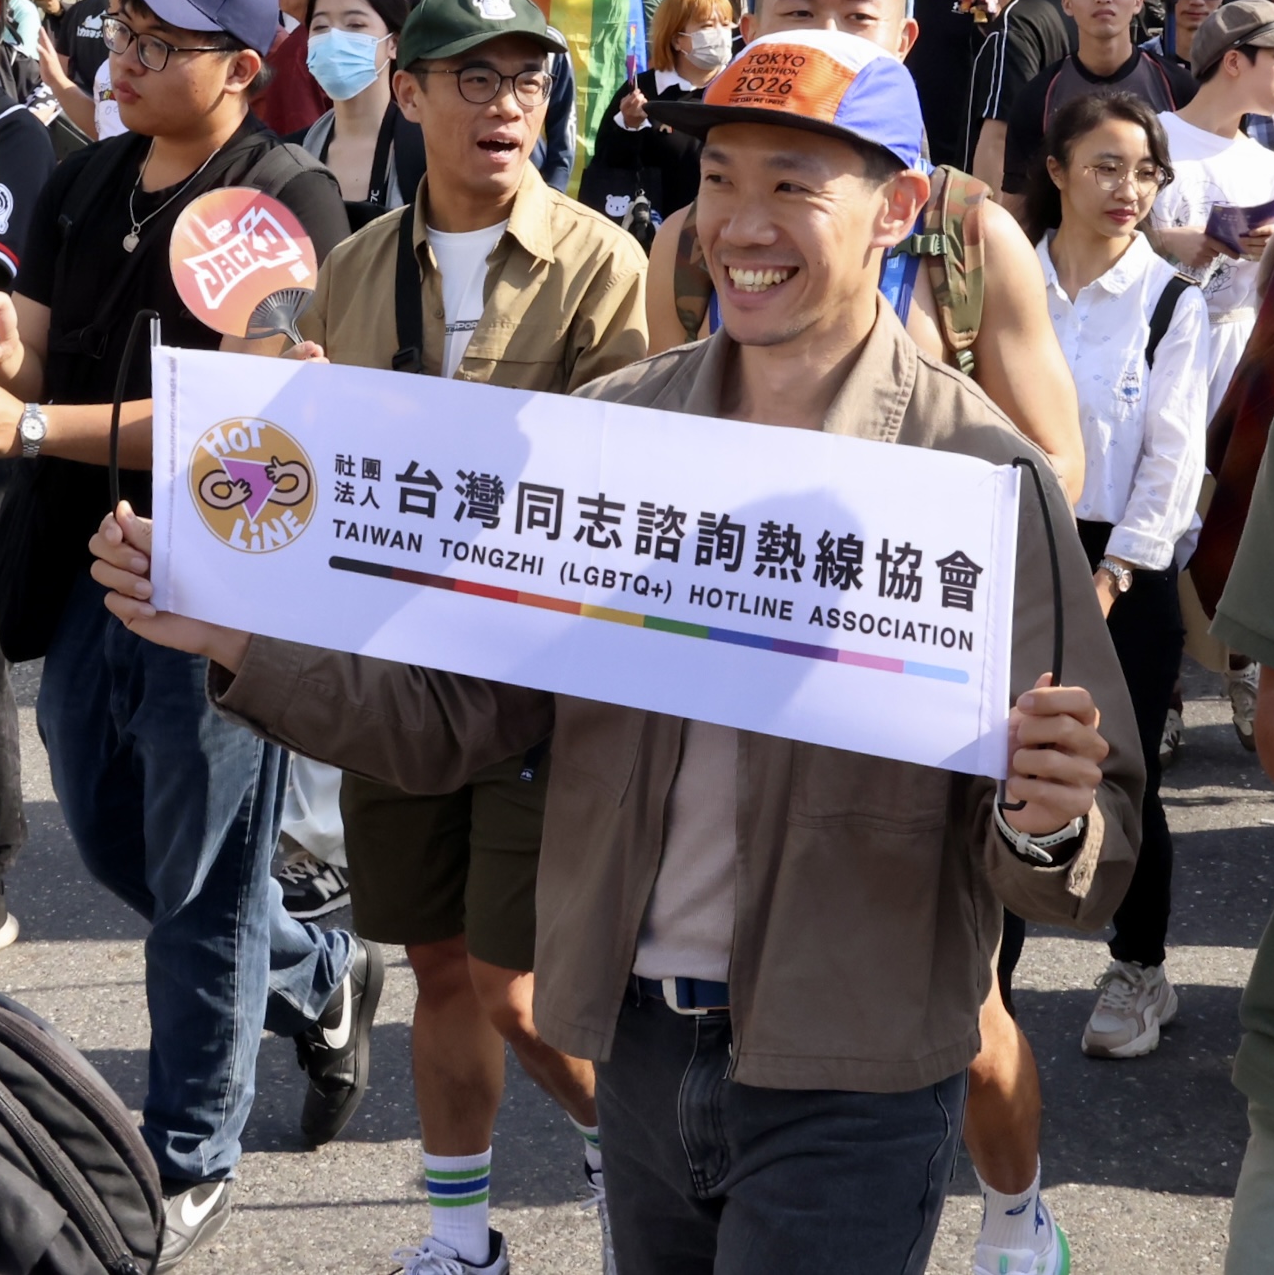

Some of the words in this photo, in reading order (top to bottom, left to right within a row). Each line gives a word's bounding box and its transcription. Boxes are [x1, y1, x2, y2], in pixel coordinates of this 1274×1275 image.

[741, 67, 799, 77] MARATHON
[748, 53, 805, 67] TOKYO
[732, 76, 792, 95] 2026
[199, 420, 267, 459] HOT
[334, 454, 382, 482] 社團
[333, 482, 381, 510] 法人
[395, 460, 983, 612] 台灣同志諮詢熱線協會
[332, 519, 423, 553] TAIWAN
[439, 538, 544, 577] TONGZHI
[560, 560, 673, 604] (LGBTQ+)
[689, 585, 794, 621] HOTLINE
[809, 605, 974, 652] ASSOCIATION
